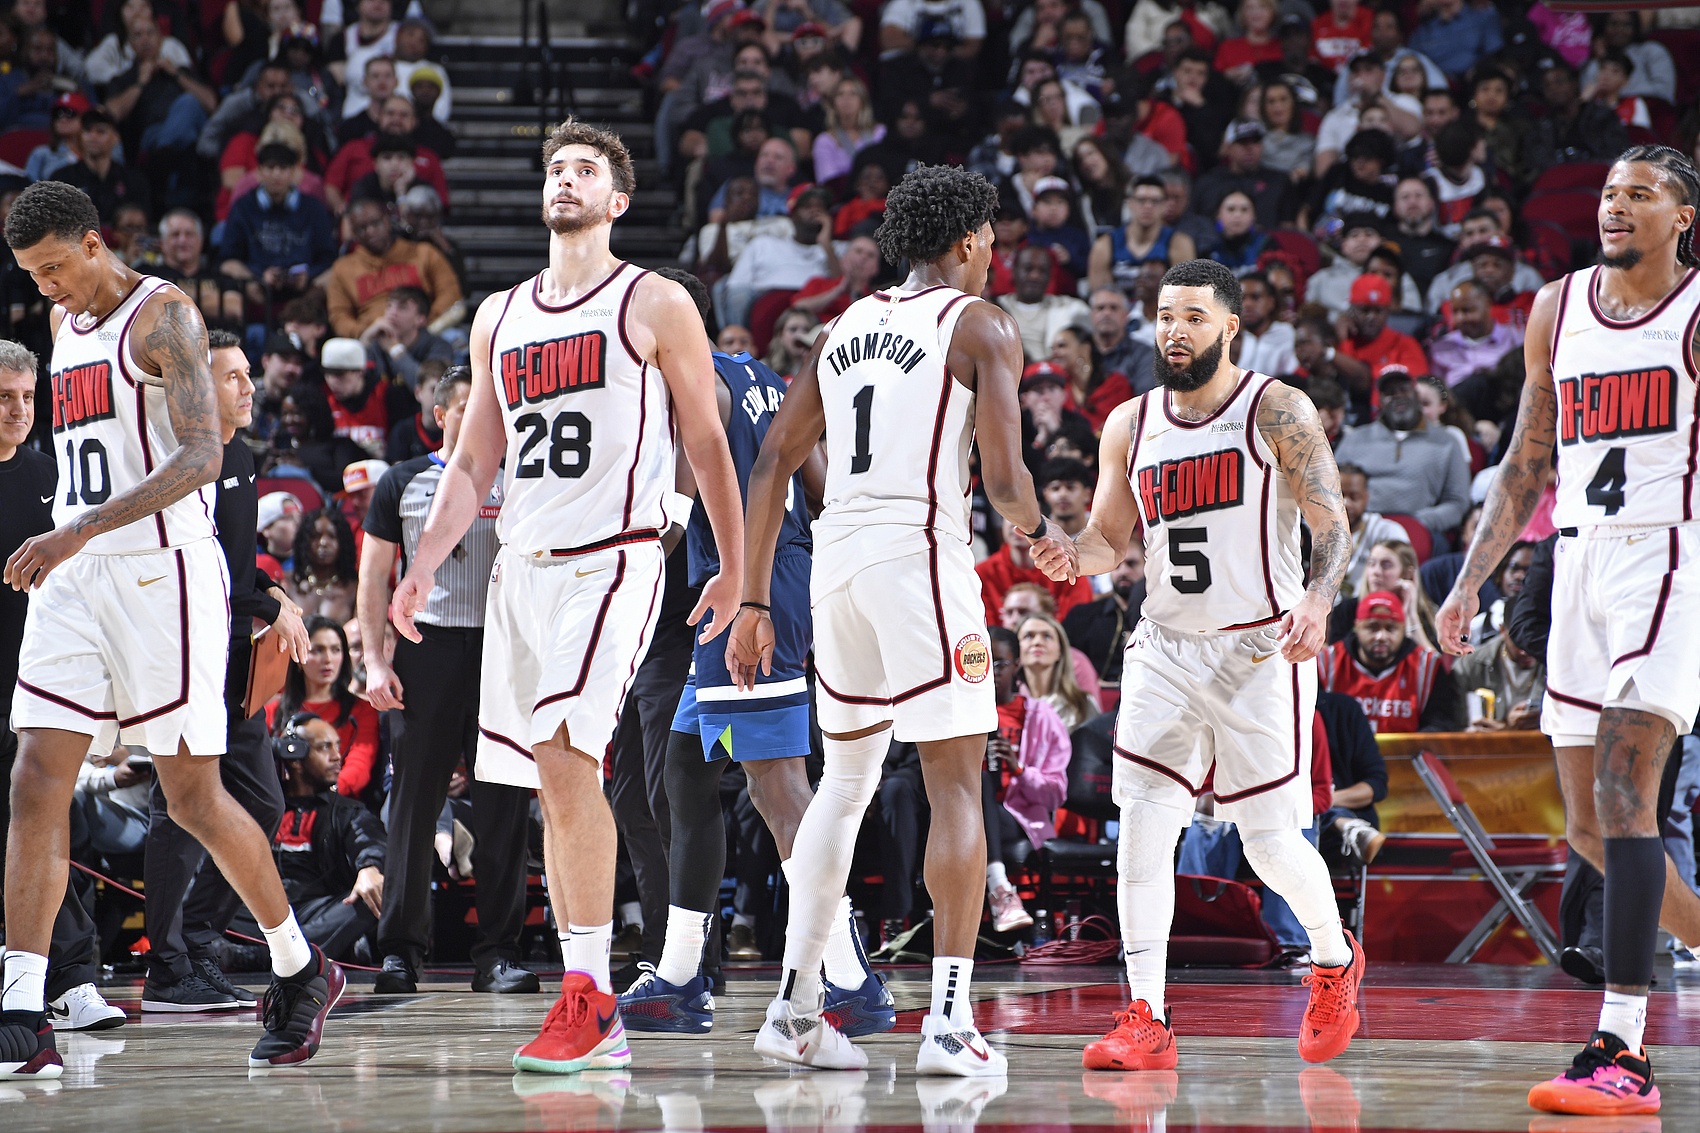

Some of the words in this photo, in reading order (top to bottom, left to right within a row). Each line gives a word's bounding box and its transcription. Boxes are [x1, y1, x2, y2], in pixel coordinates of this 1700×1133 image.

[826, 332, 927, 377] THOMPSON
[741, 385, 785, 425] EDWR
[850, 384, 875, 475] 1
[66, 438, 112, 505] 10
[514, 411, 592, 479] 28
[113, 506, 130, 518] love
[137, 491, 154, 504] God
[1585, 447, 1627, 516] 4
[1168, 527, 1212, 594] 5
